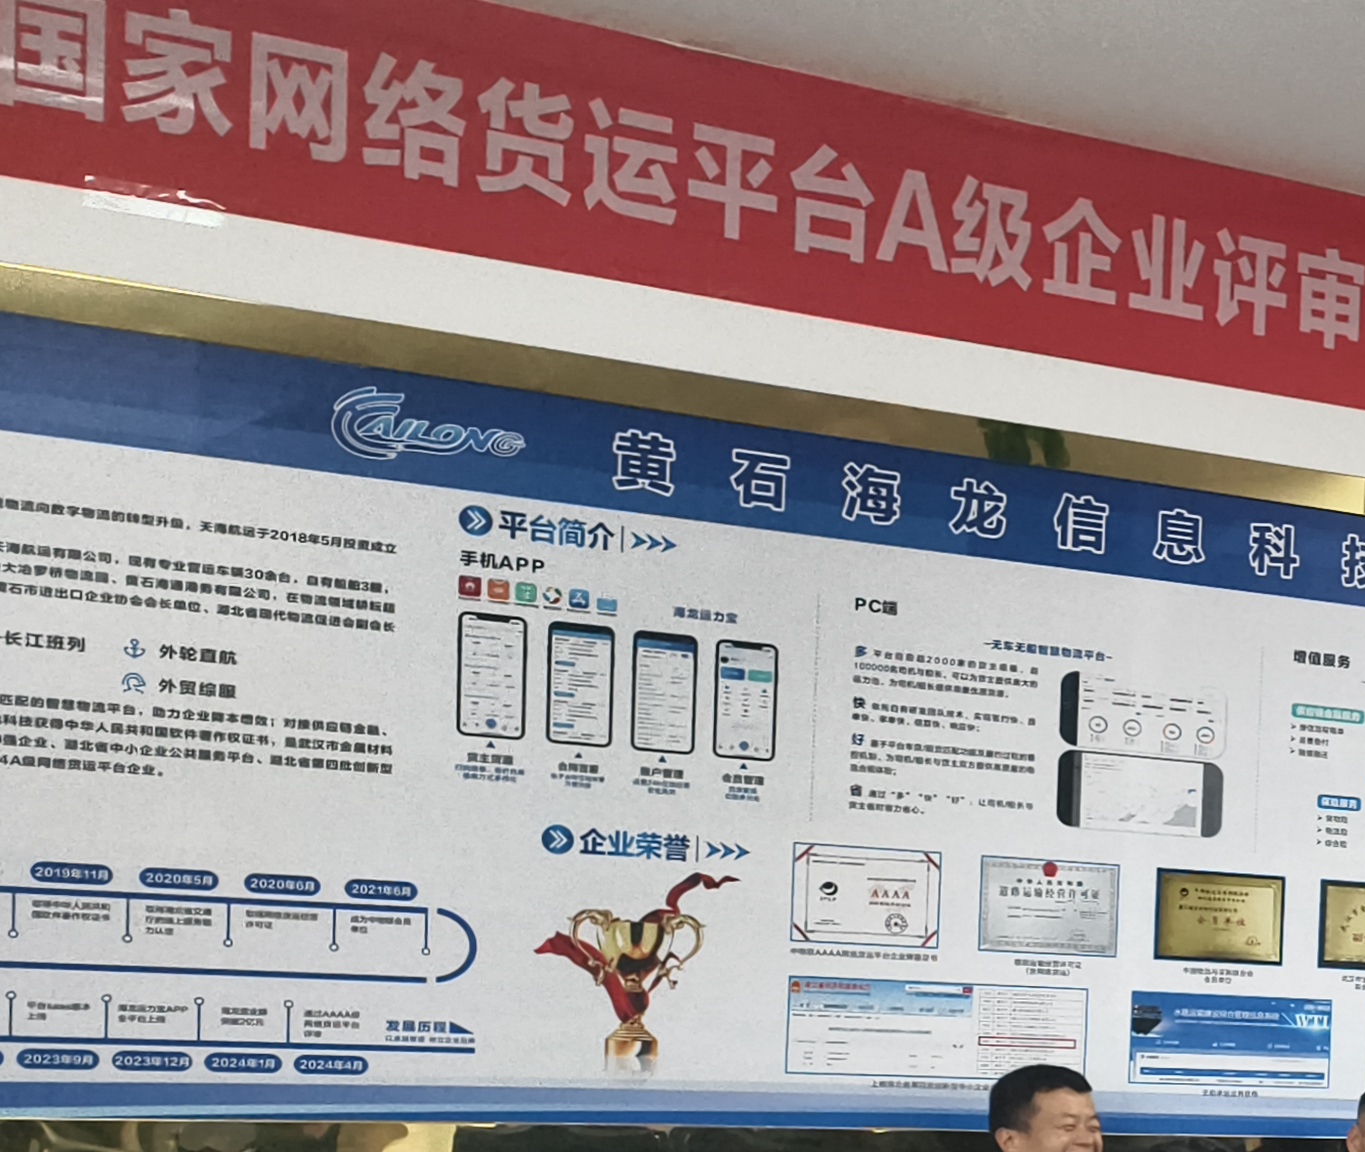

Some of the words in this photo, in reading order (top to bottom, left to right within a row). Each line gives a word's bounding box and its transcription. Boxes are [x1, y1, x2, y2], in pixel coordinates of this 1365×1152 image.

[498, 509, 615, 551] 平台简介
[459, 550, 546, 573] 手机APP
[853, 596, 898, 616] PC端
[158, 644, 238, 666] 外轮直航
[1292, 649, 1351, 670] 增值服务
[158, 677, 237, 700] 外贸综服
[852, 696, 866, 709] 快
[579, 826, 692, 866] 企业荣誉
[34, 866, 110, 881] 2019年11月
[145, 872, 213, 886] 2020年5月
[250, 877, 316, 892] 2020年6月
[385, 1019, 448, 1033] 发展历程
[23, 1053, 94, 1066] 2023年9月
[114, 1054, 190, 1067] 2023年12月
[211, 1056, 276, 1069] 2024年1月
[299, 1059, 363, 1071] 2024年4月
